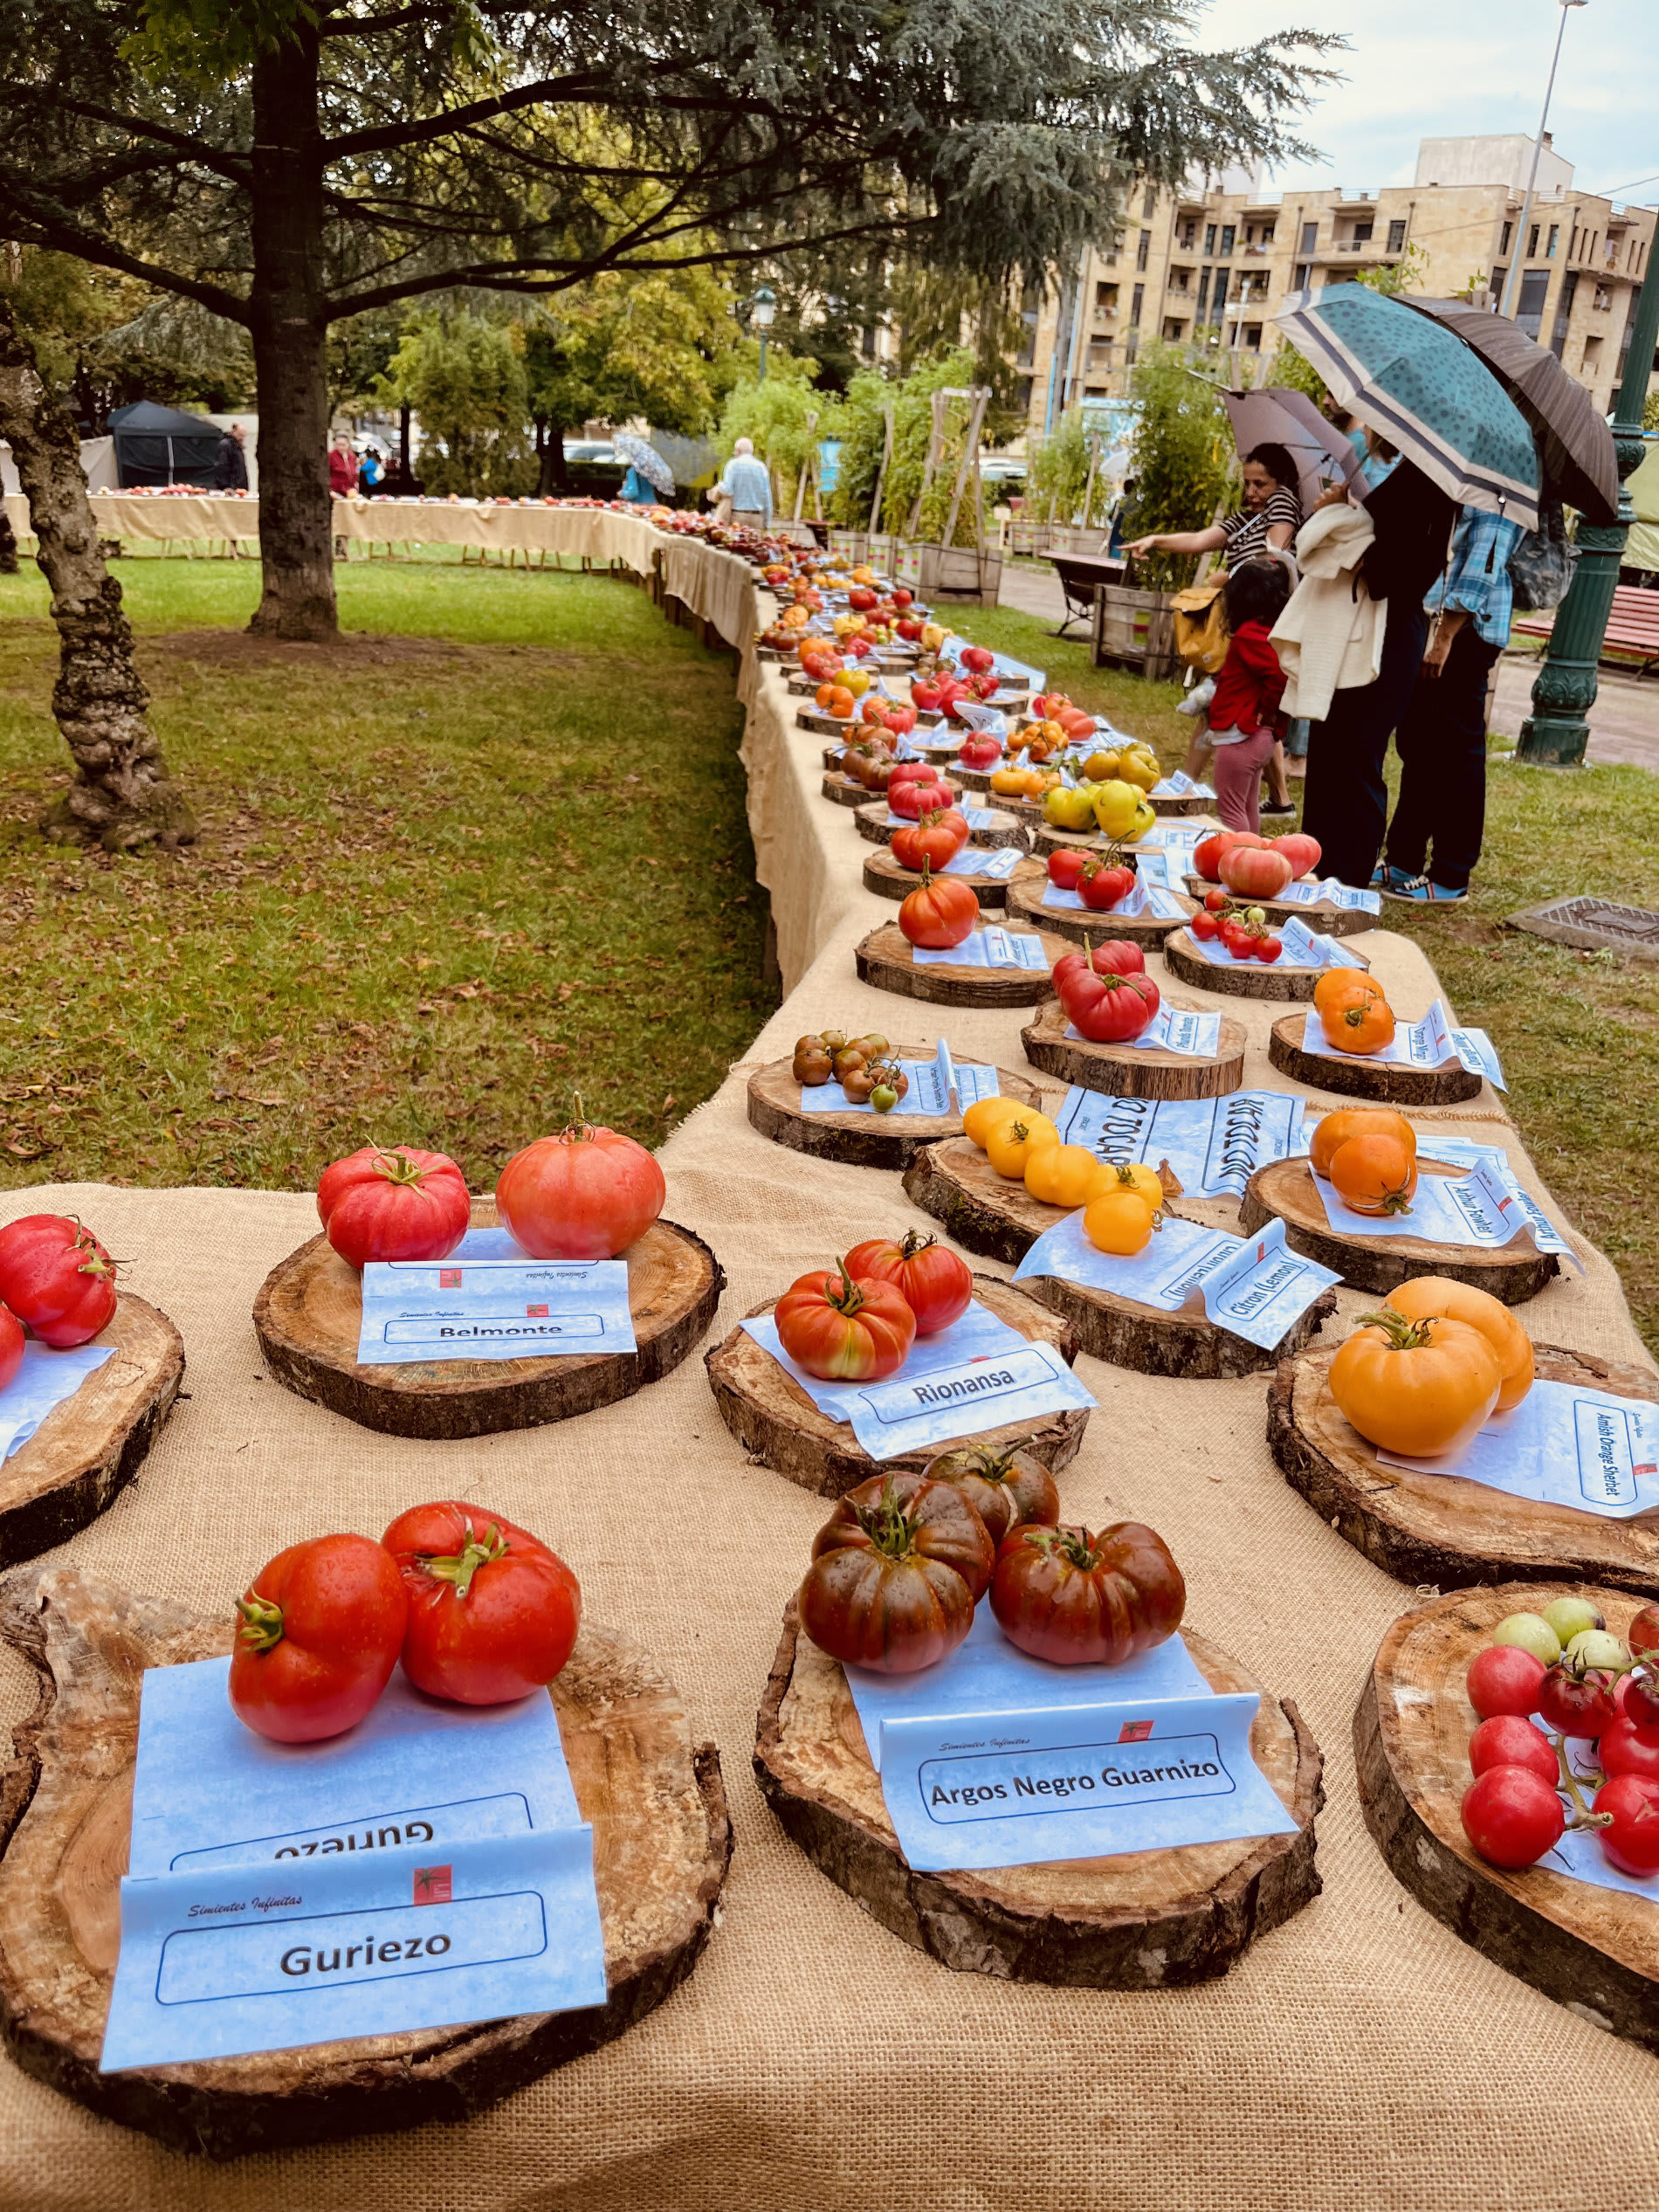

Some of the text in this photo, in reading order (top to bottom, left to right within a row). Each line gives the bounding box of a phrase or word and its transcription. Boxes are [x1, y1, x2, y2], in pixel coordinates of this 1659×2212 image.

[1218, 1098, 1264, 1182] NO TOCAR
[1452, 1186, 1477, 1211] Arthur
[1468, 1209, 1493, 1233] Fowler
[1532, 1216, 1559, 1240] Arthur
[1229, 1289, 1263, 1315] Citron
[1260, 1260, 1298, 1296] (Lemon)
[440, 1324, 563, 1338] Belmonte
[911, 1369, 1015, 1404] Rionansa
[1596, 1412, 1621, 1496] Amish Orange Sherbet
[931, 1759, 1220, 1807] Argos Negro Guarnizo
[188, 1894, 303, 1918] Simientes Infinitas
[279, 1933, 452, 1976] Guriezo
